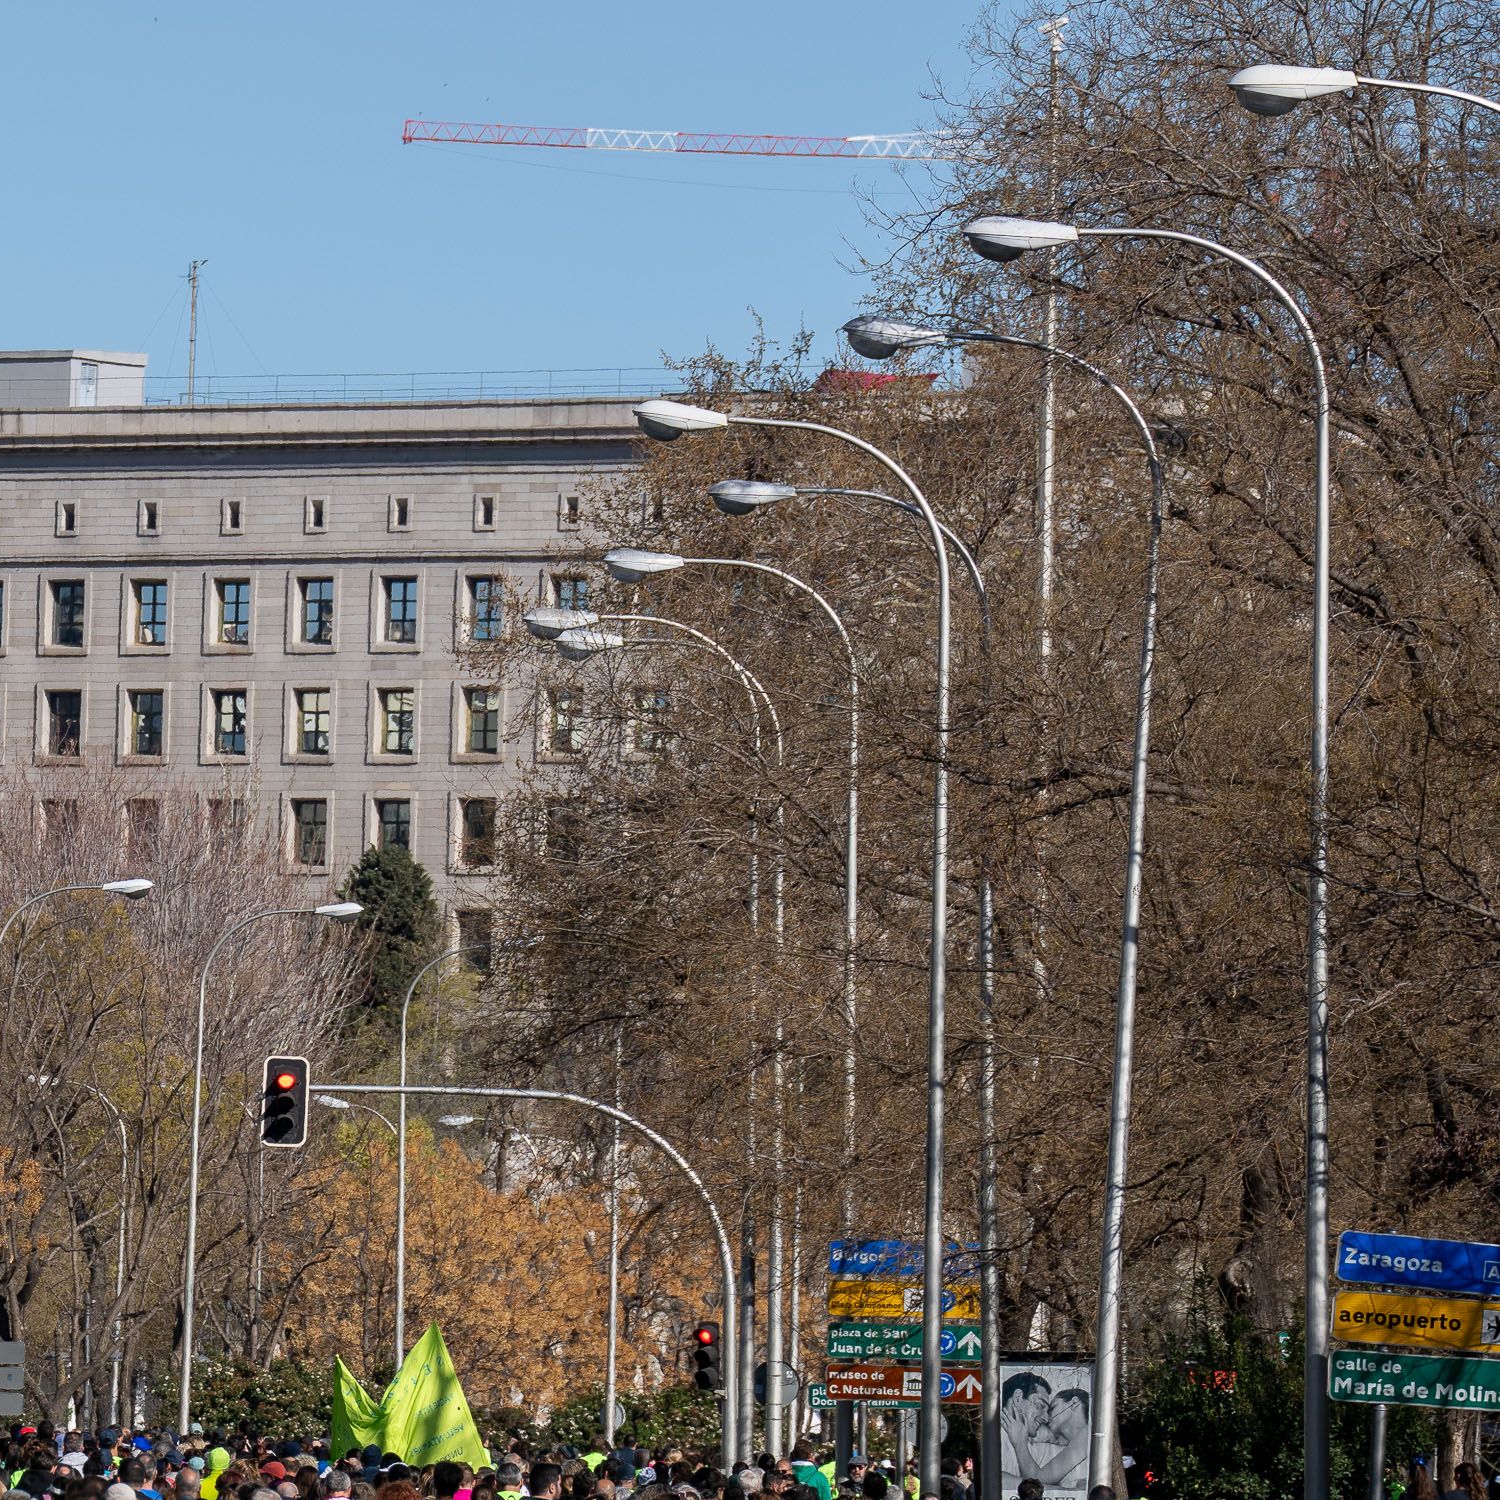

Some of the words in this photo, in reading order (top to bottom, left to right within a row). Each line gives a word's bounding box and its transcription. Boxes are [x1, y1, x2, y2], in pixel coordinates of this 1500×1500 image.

[832, 1249, 883, 1264] Brgo
[1344, 1247, 1443, 1273] Zaragoza
[1339, 1310, 1462, 1332] aeropuerto
[831, 1328, 861, 1339] plaza
[864, 1328, 878, 1338] de
[882, 1329, 908, 1339] San
[831, 1342, 862, 1354] Juan
[865, 1343, 882, 1355] de
[886, 1344, 897, 1355] la
[901, 1345, 922, 1356] Cru
[1336, 1358, 1377, 1372] calle
[1381, 1360, 1402, 1374] de
[829, 1371, 868, 1380] museo
[871, 1371, 885, 1381] de
[829, 1386, 841, 1395] C.
[843, 1386, 900, 1396] Naturales
[1334, 1377, 1395, 1397] María
[1402, 1382, 1429, 1399] de
